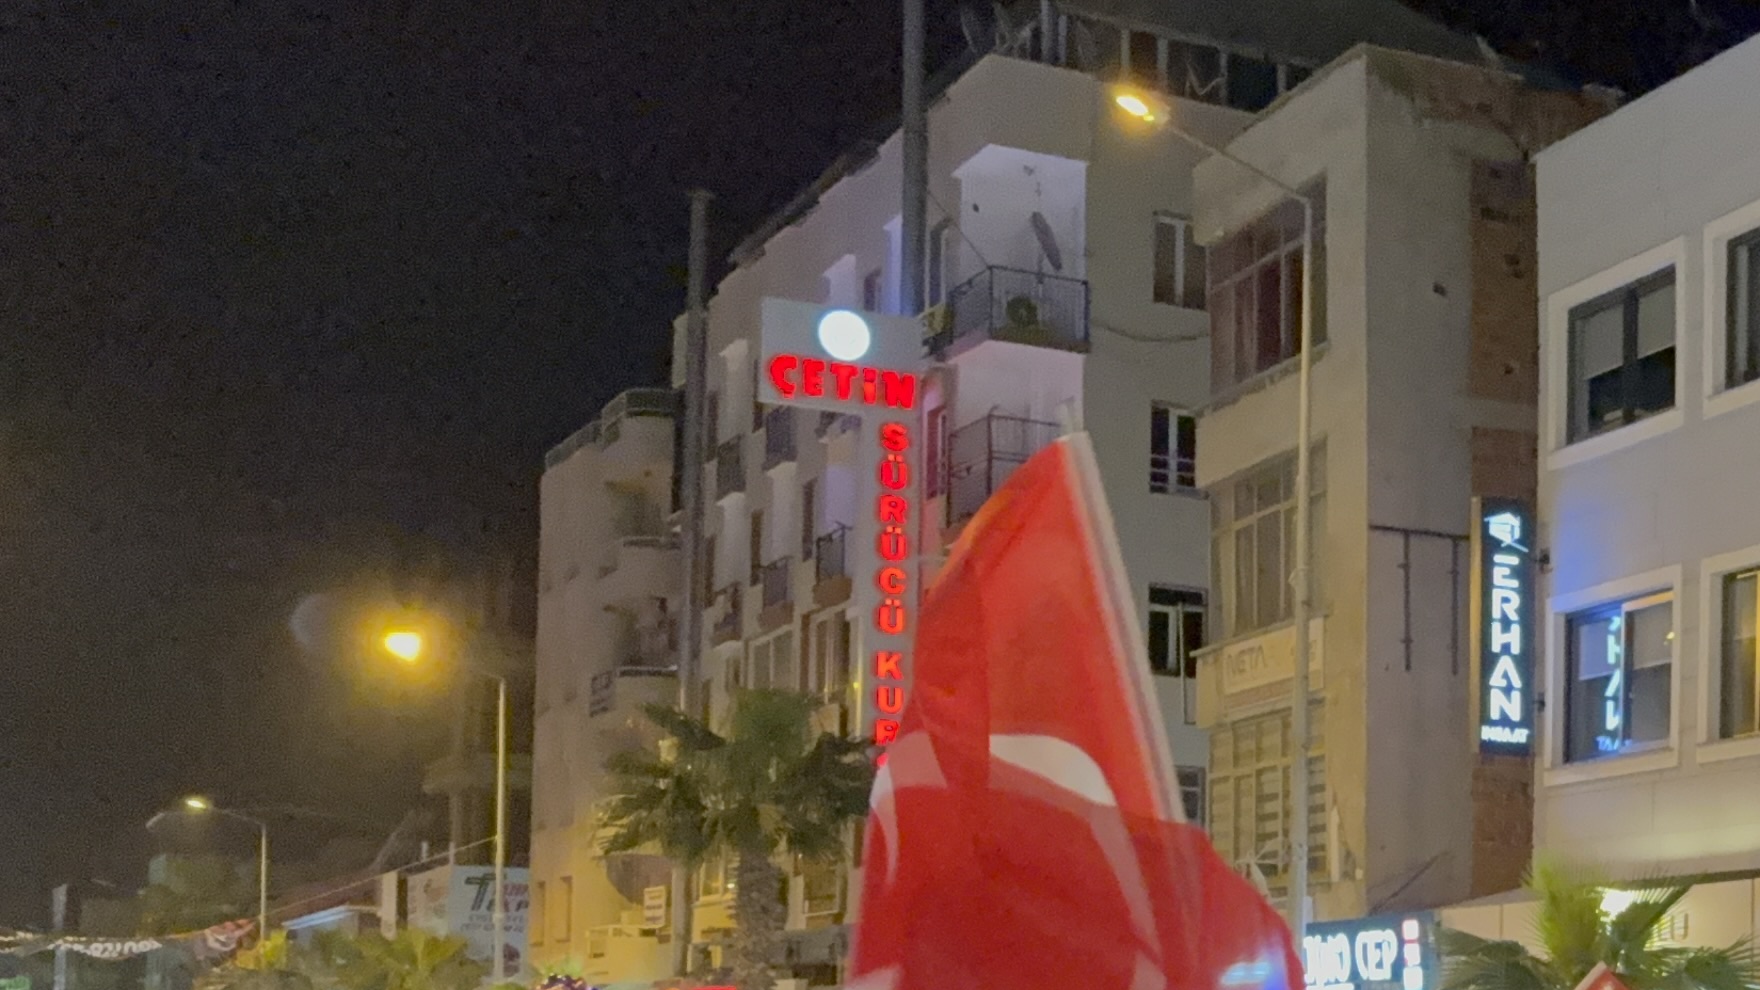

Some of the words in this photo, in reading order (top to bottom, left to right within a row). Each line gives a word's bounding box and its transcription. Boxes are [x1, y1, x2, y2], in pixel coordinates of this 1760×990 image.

[879, 424, 908, 635] SÜRÜCÜ
[876, 651, 902, 767] KUR
[1488, 554, 1523, 723] ERHAN
